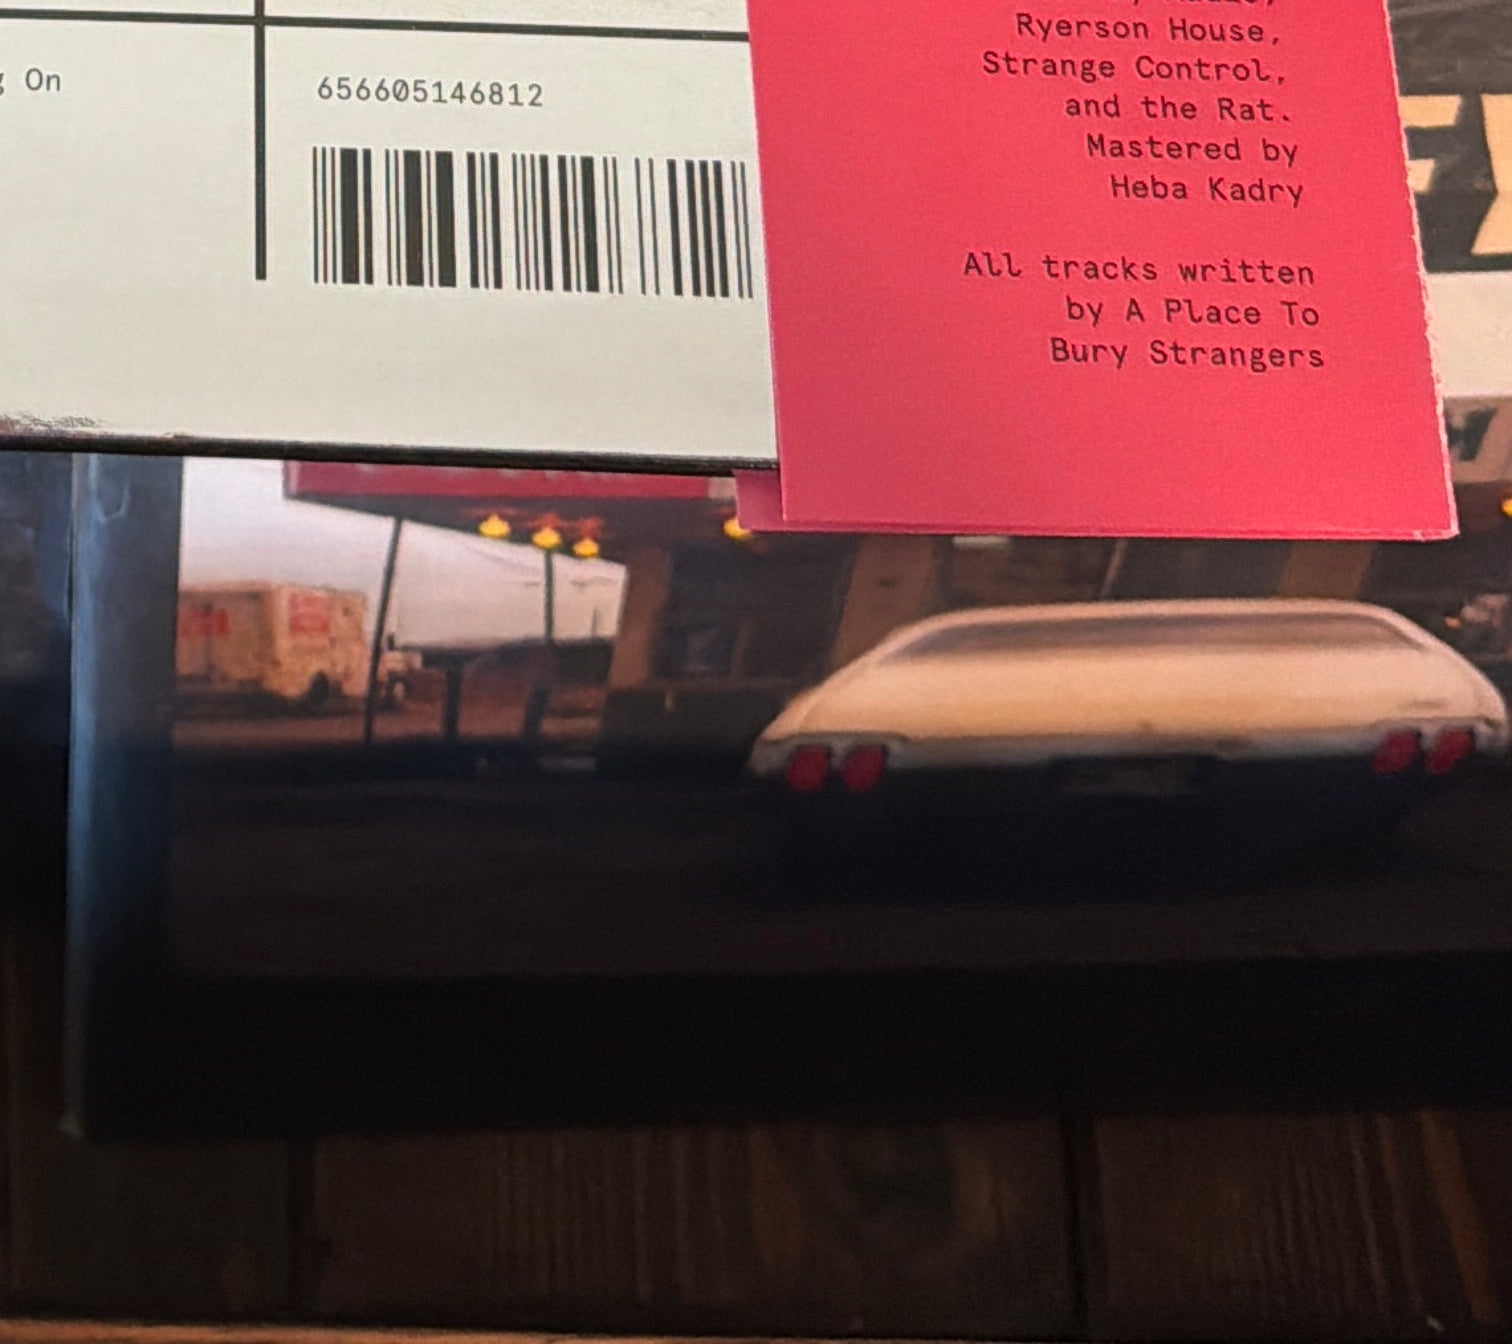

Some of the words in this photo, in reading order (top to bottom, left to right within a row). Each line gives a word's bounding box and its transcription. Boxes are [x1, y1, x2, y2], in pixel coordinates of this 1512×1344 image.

[1016, 13, 1148, 41] Ryerson
[1169, 17, 1280, 46] House,
[25, 68, 61, 91] On
[983, 51, 1115, 82] Strange
[1136, 55, 1286, 86] Control,
[318, 76, 543, 107] 656605146812
[1065, 94, 1119, 118] and
[1140, 95, 1197, 120] the
[1218, 98, 1290, 122] Rat.
[1087, 134, 1240, 161] Mastered
[1263, 138, 1298, 167] by
[1111, 175, 1187, 200] Heba
[1209, 177, 1303, 209] Kadry
[963, 252, 1022, 278] All
[1041, 255, 1157, 281] tracks
[1178, 258, 1314, 285] written
[1067, 296, 1103, 326] by
[1126, 298, 1145, 322] A
[1164, 299, 1261, 325] Place
[1281, 301, 1319, 327] To
[1050, 337, 1128, 369] Bury
[1150, 340, 1325, 374] Strangers
